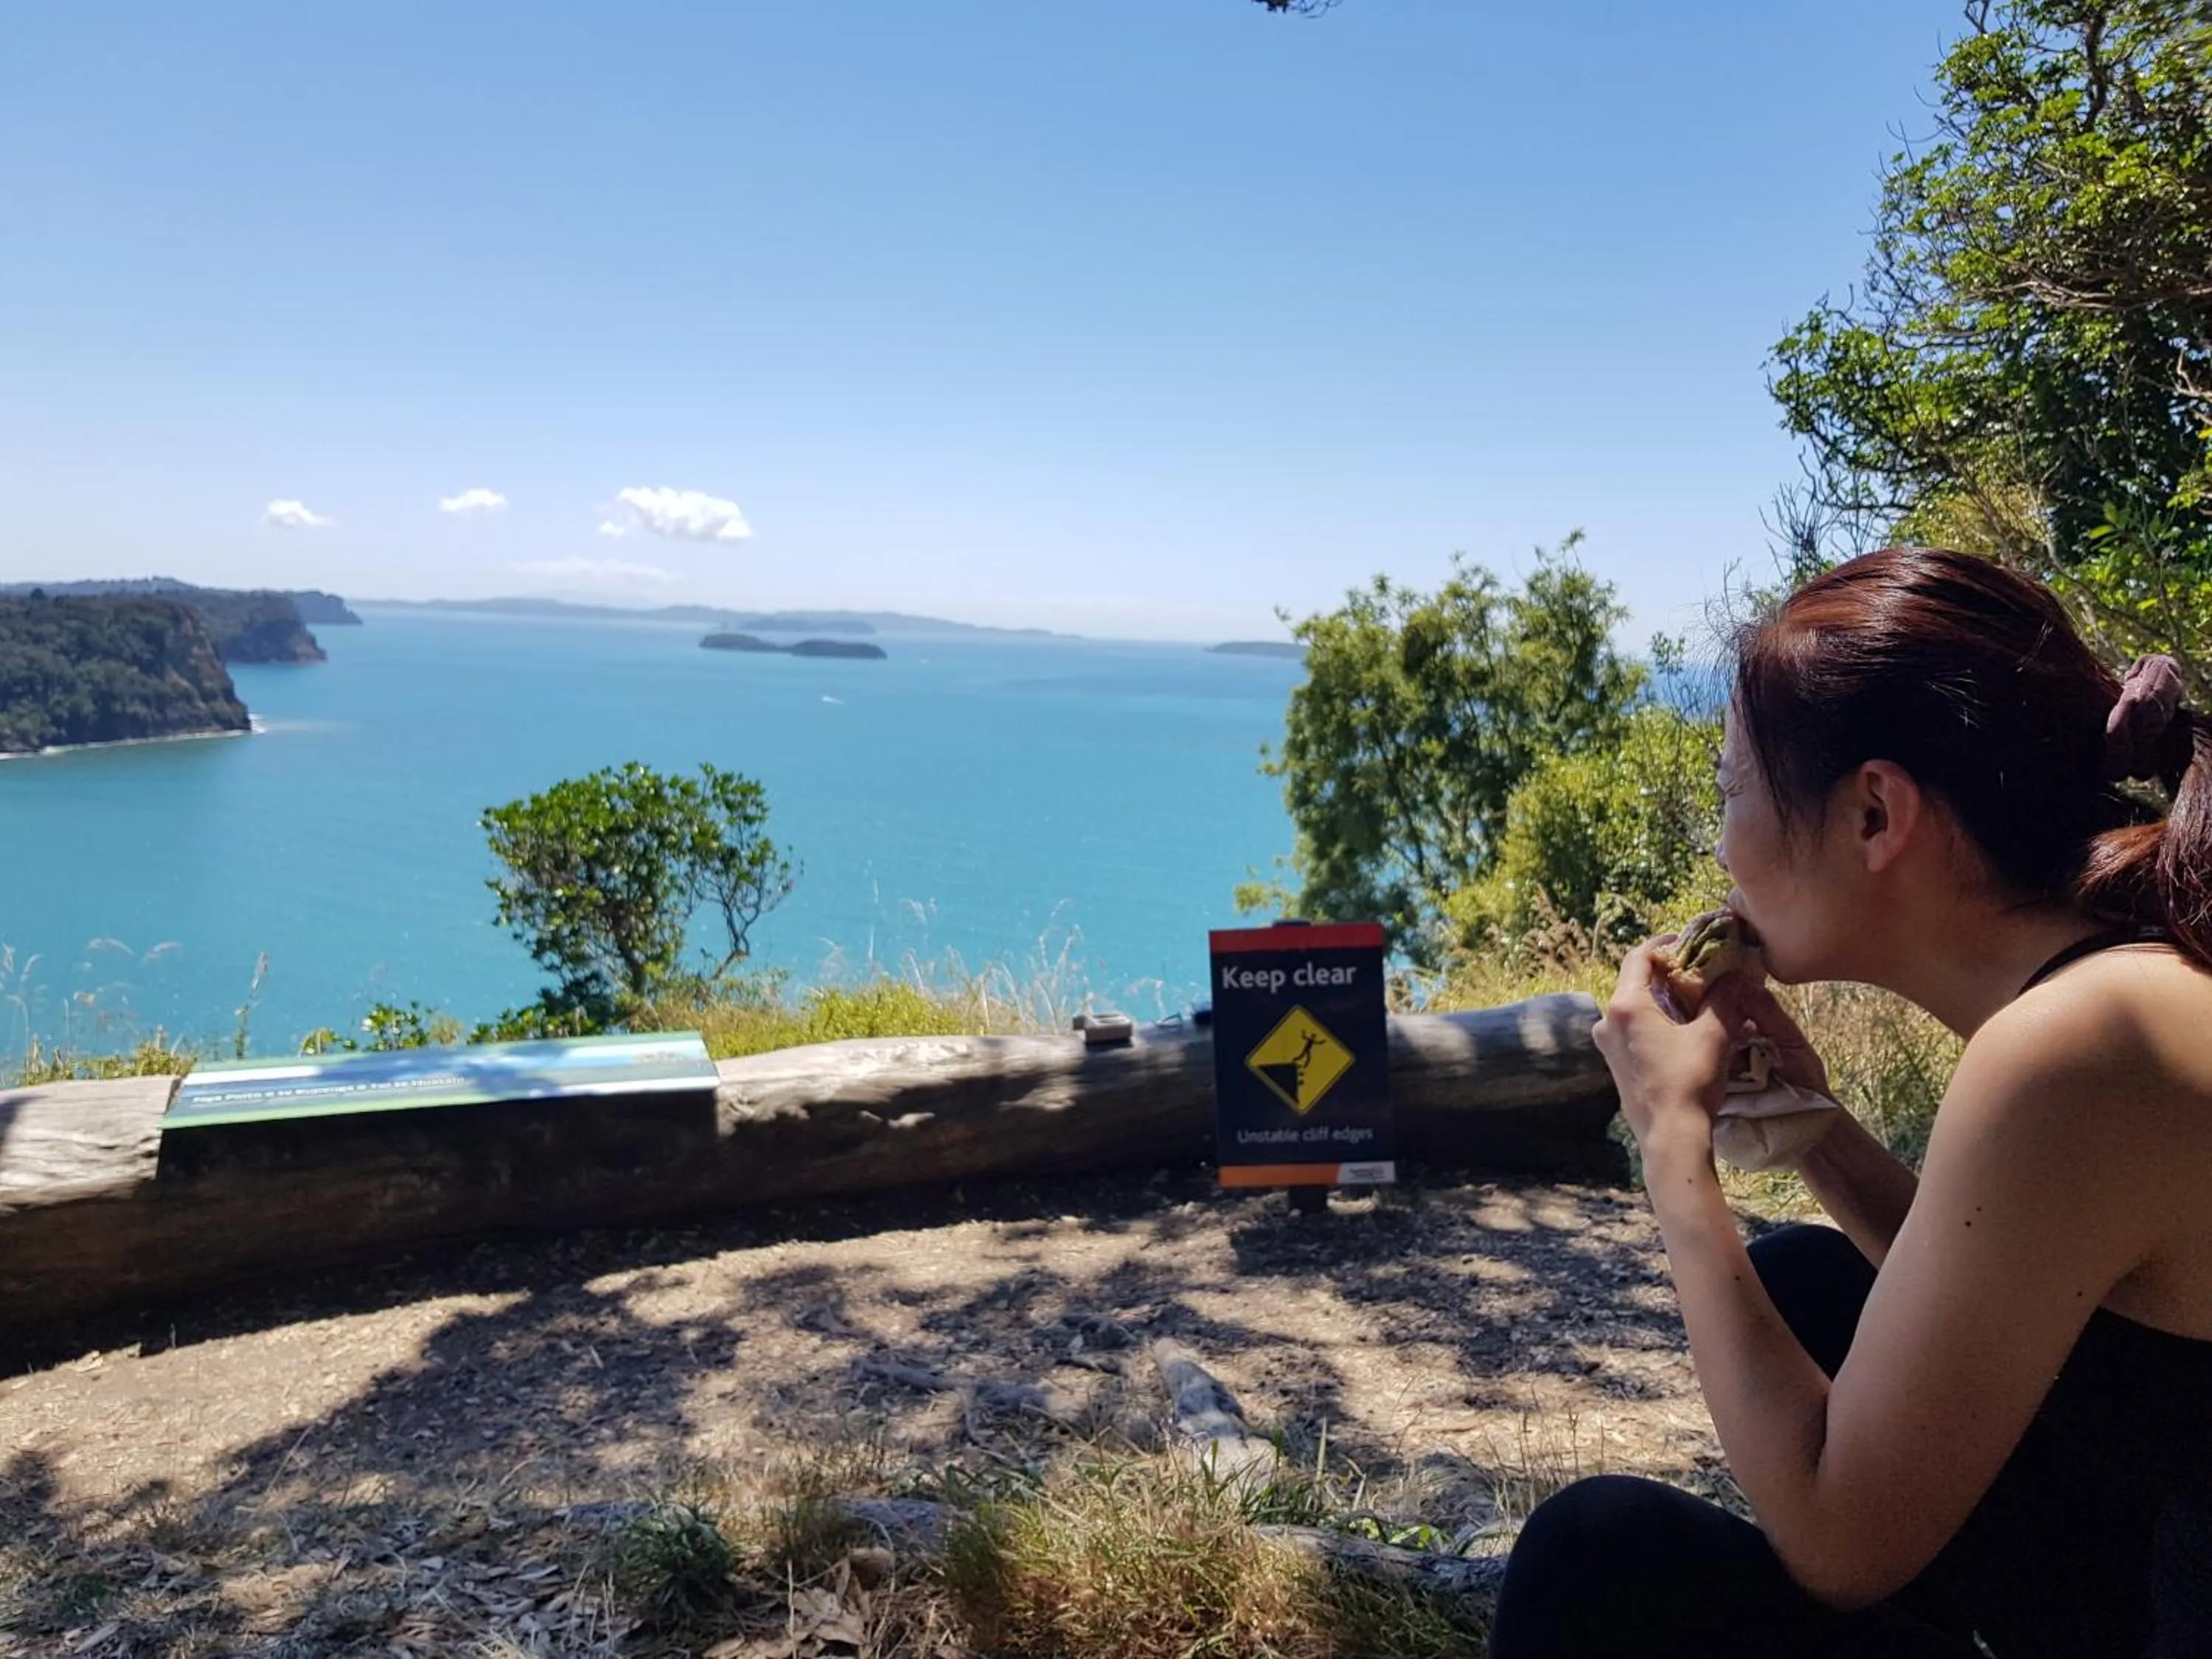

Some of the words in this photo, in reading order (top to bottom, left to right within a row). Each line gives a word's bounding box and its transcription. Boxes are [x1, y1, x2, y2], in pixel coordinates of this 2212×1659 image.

[1222, 965, 1286, 993] Keep
[1293, 961, 1357, 987] clear
[1237, 1128, 1298, 1144] Unstable
[1302, 1126, 1329, 1141] cliff
[1332, 1125, 1374, 1144] edges
